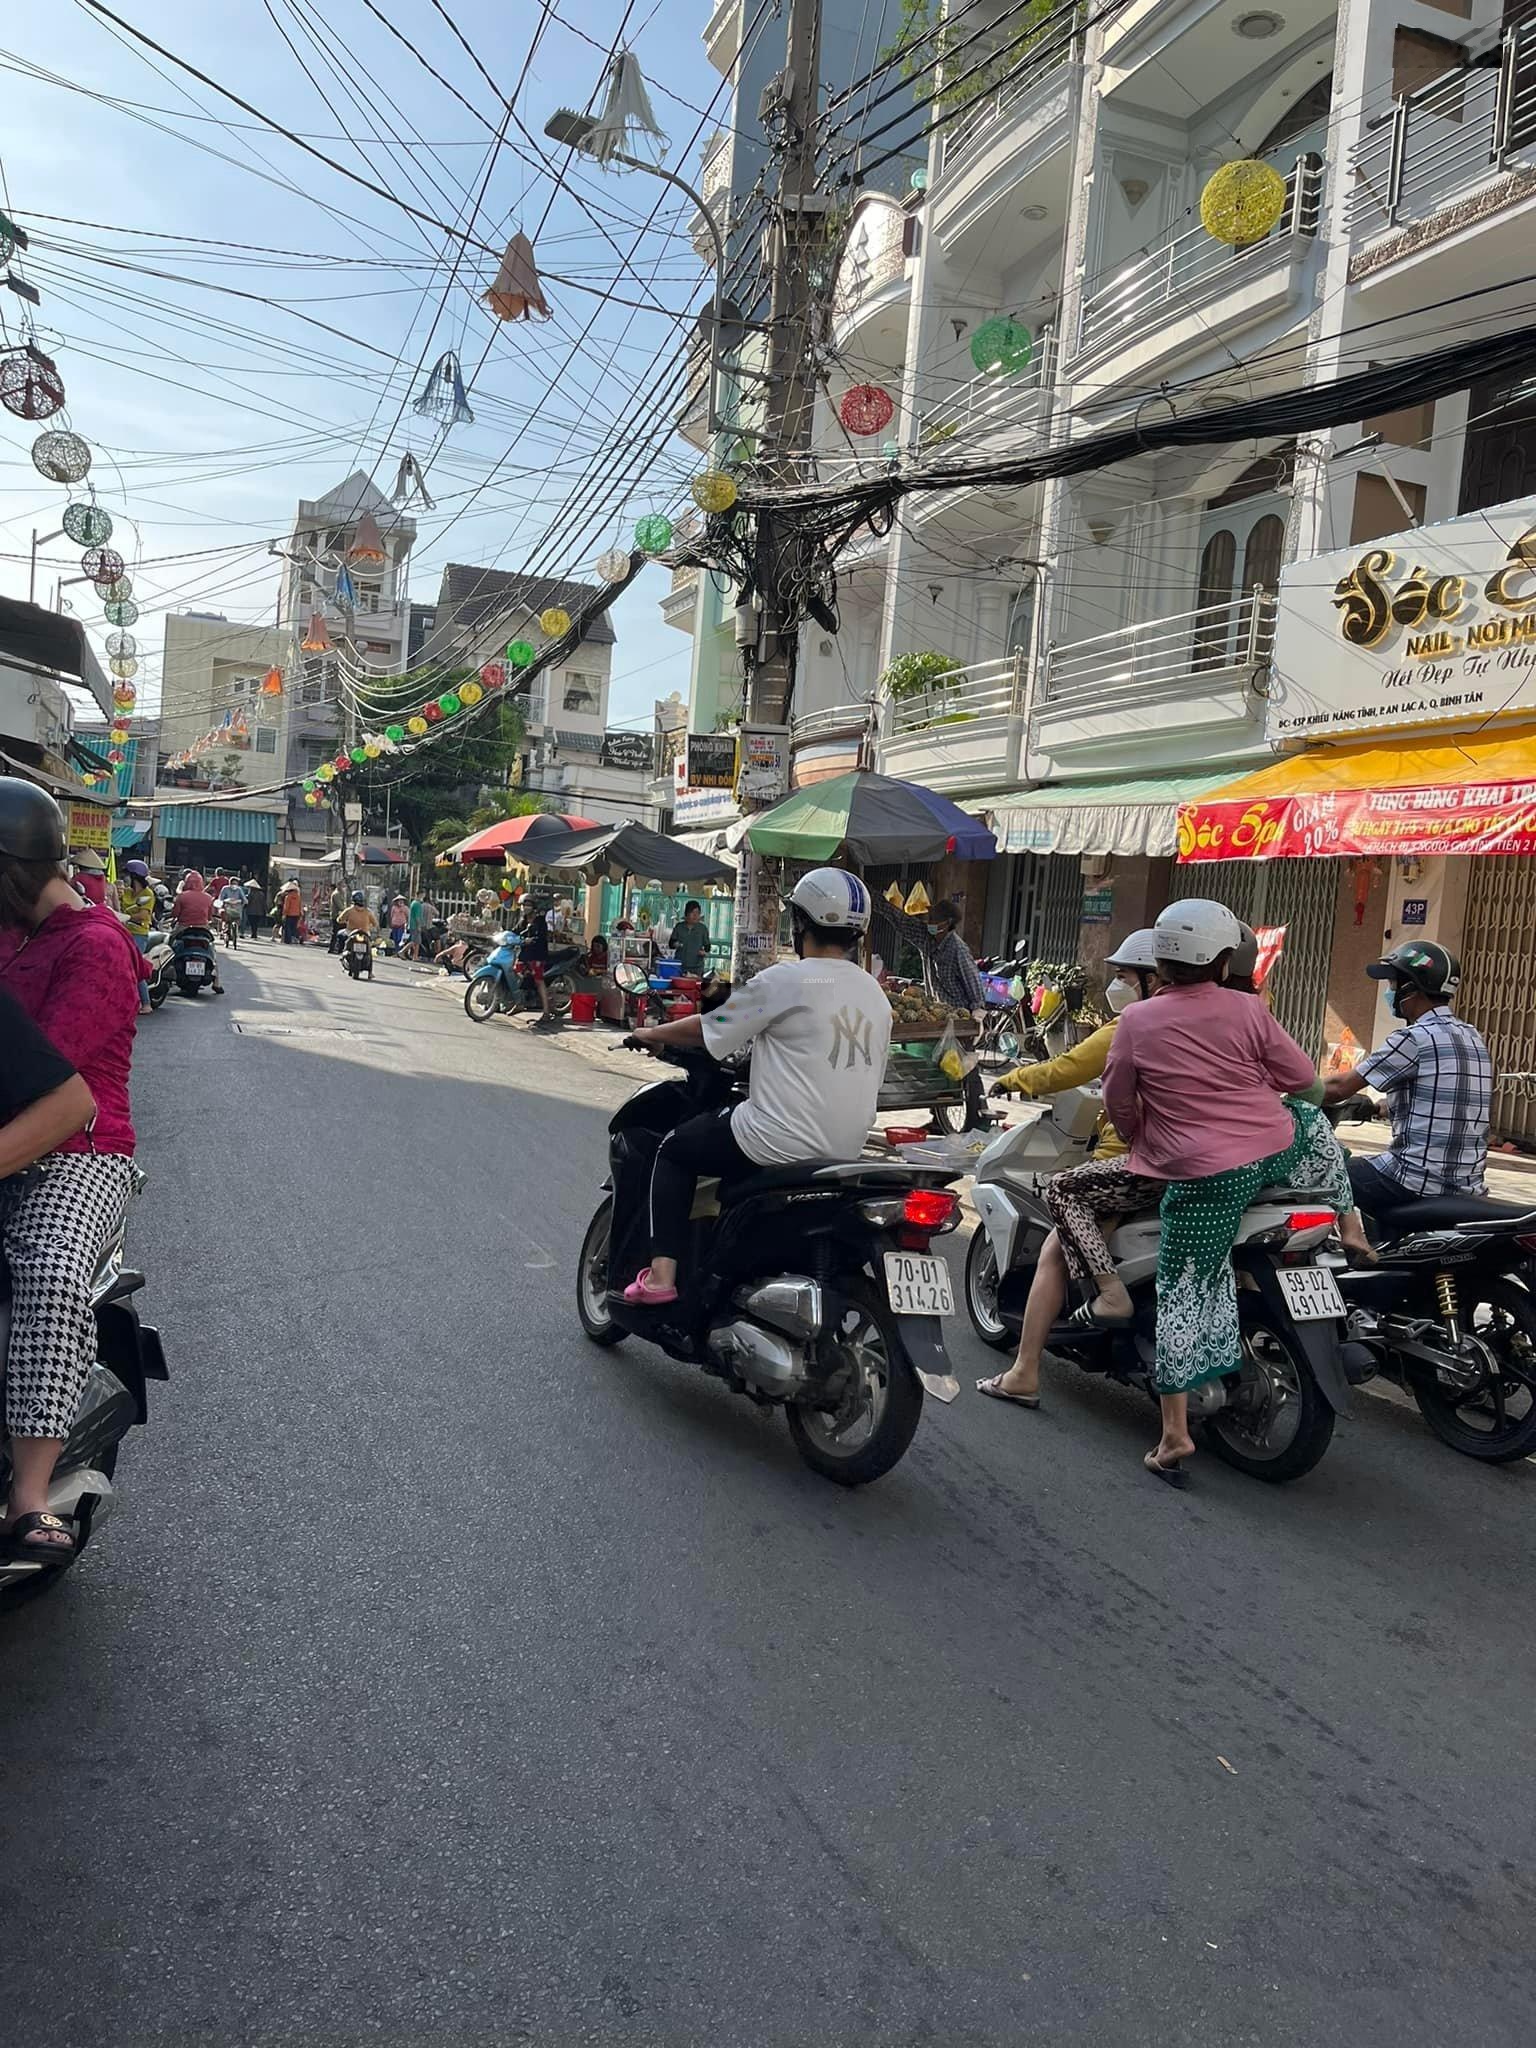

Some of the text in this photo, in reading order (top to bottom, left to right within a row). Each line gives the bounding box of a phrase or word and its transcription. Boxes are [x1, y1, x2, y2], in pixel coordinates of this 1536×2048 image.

[1331, 550, 1463, 647] Sóc
[1406, 631, 1450, 657] NAIL
[1468, 613, 1506, 646] NỐI
[1382, 669, 1413, 688] Nét
[1417, 663, 1453, 684] Đẹp
[1464, 656, 1491, 678] Tự
[1386, 704, 1399, 714] AN
[1401, 701, 1417, 713] LẠC
[1439, 694, 1462, 707] BÌNH
[1464, 691, 1483, 704] TÂN
[704, 775, 718, 787] NHI
[1412, 788, 1459, 810] BỪNG
[1462, 785, 1508, 807] KHAI
[1178, 802, 1286, 857] Sóc Spa
[1304, 816, 1339, 856] 20%
[1522, 840, 1531, 851] 2
[1405, 903, 1425, 915] 43P
[1285, 1270, 1329, 1293] 59-D2
[892, 1284, 950, 1311] 314.26
[1291, 1292, 1342, 1317] 491.44
